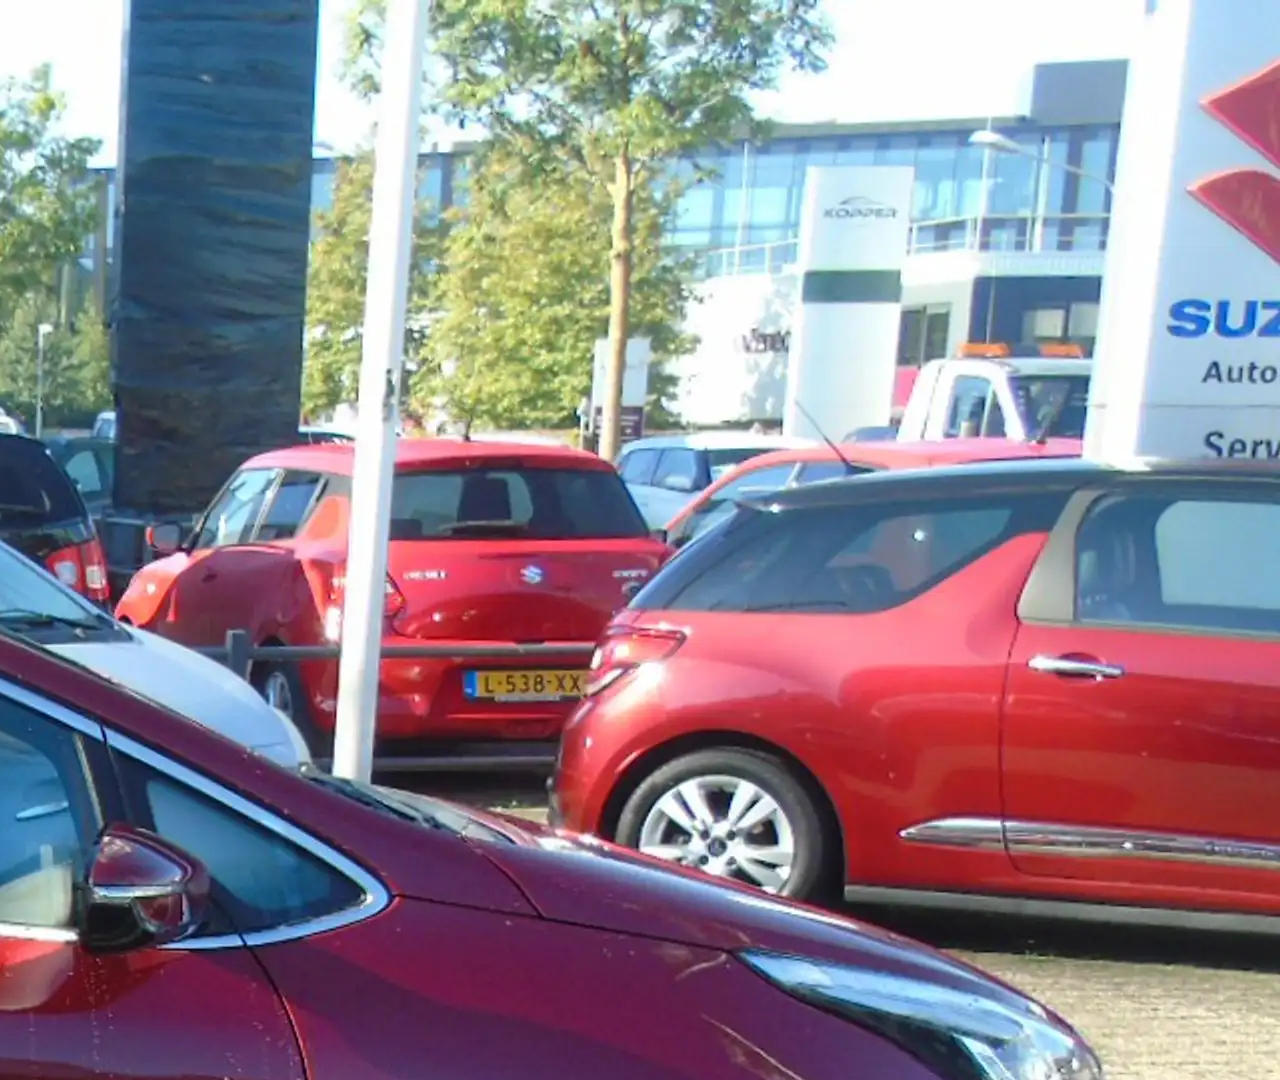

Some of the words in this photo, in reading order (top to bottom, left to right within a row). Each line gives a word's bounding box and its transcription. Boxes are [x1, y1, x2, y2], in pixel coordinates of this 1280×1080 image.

[1201, 360, 1278, 384] Auto
[1203, 430, 1280, 460] Serv
[483, 673, 581, 694] L-538-XX
